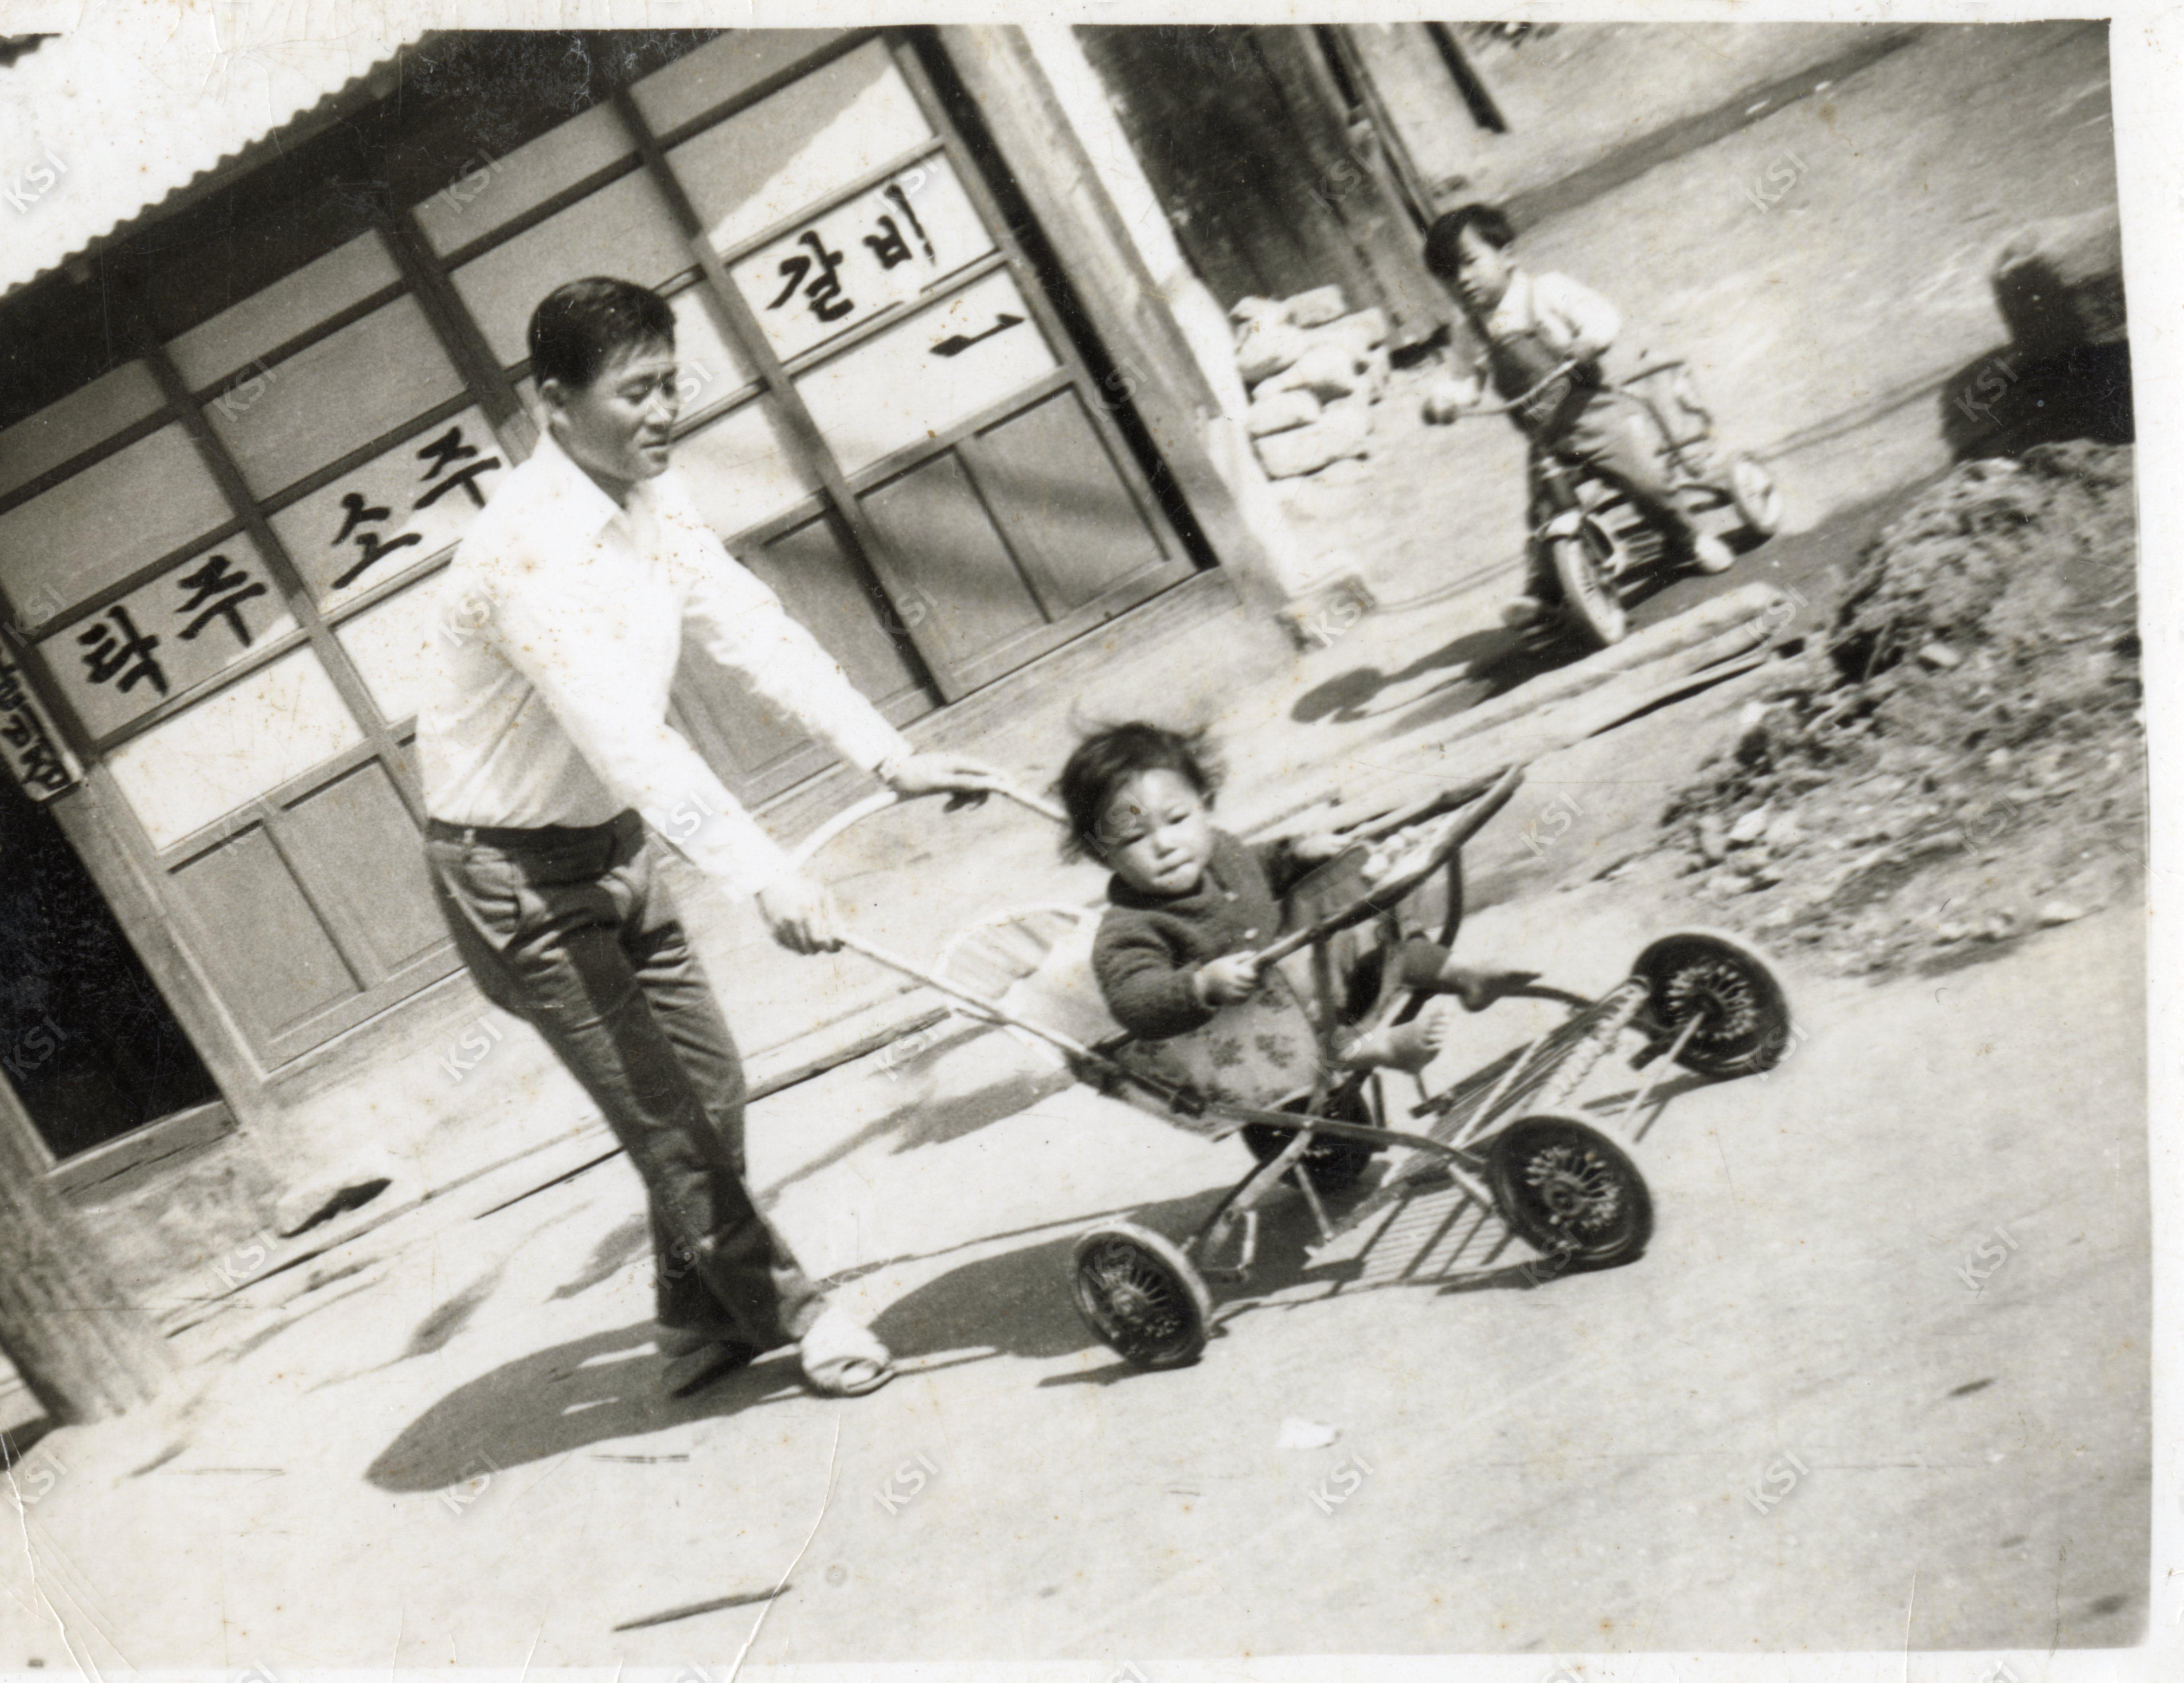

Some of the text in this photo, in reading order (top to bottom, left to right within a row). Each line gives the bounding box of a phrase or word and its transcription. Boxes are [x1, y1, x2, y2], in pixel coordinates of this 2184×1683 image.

[766, 184, 935, 322] 갈비
[331, 426, 501, 590] 소주
[77, 555, 266, 698] 탁주
